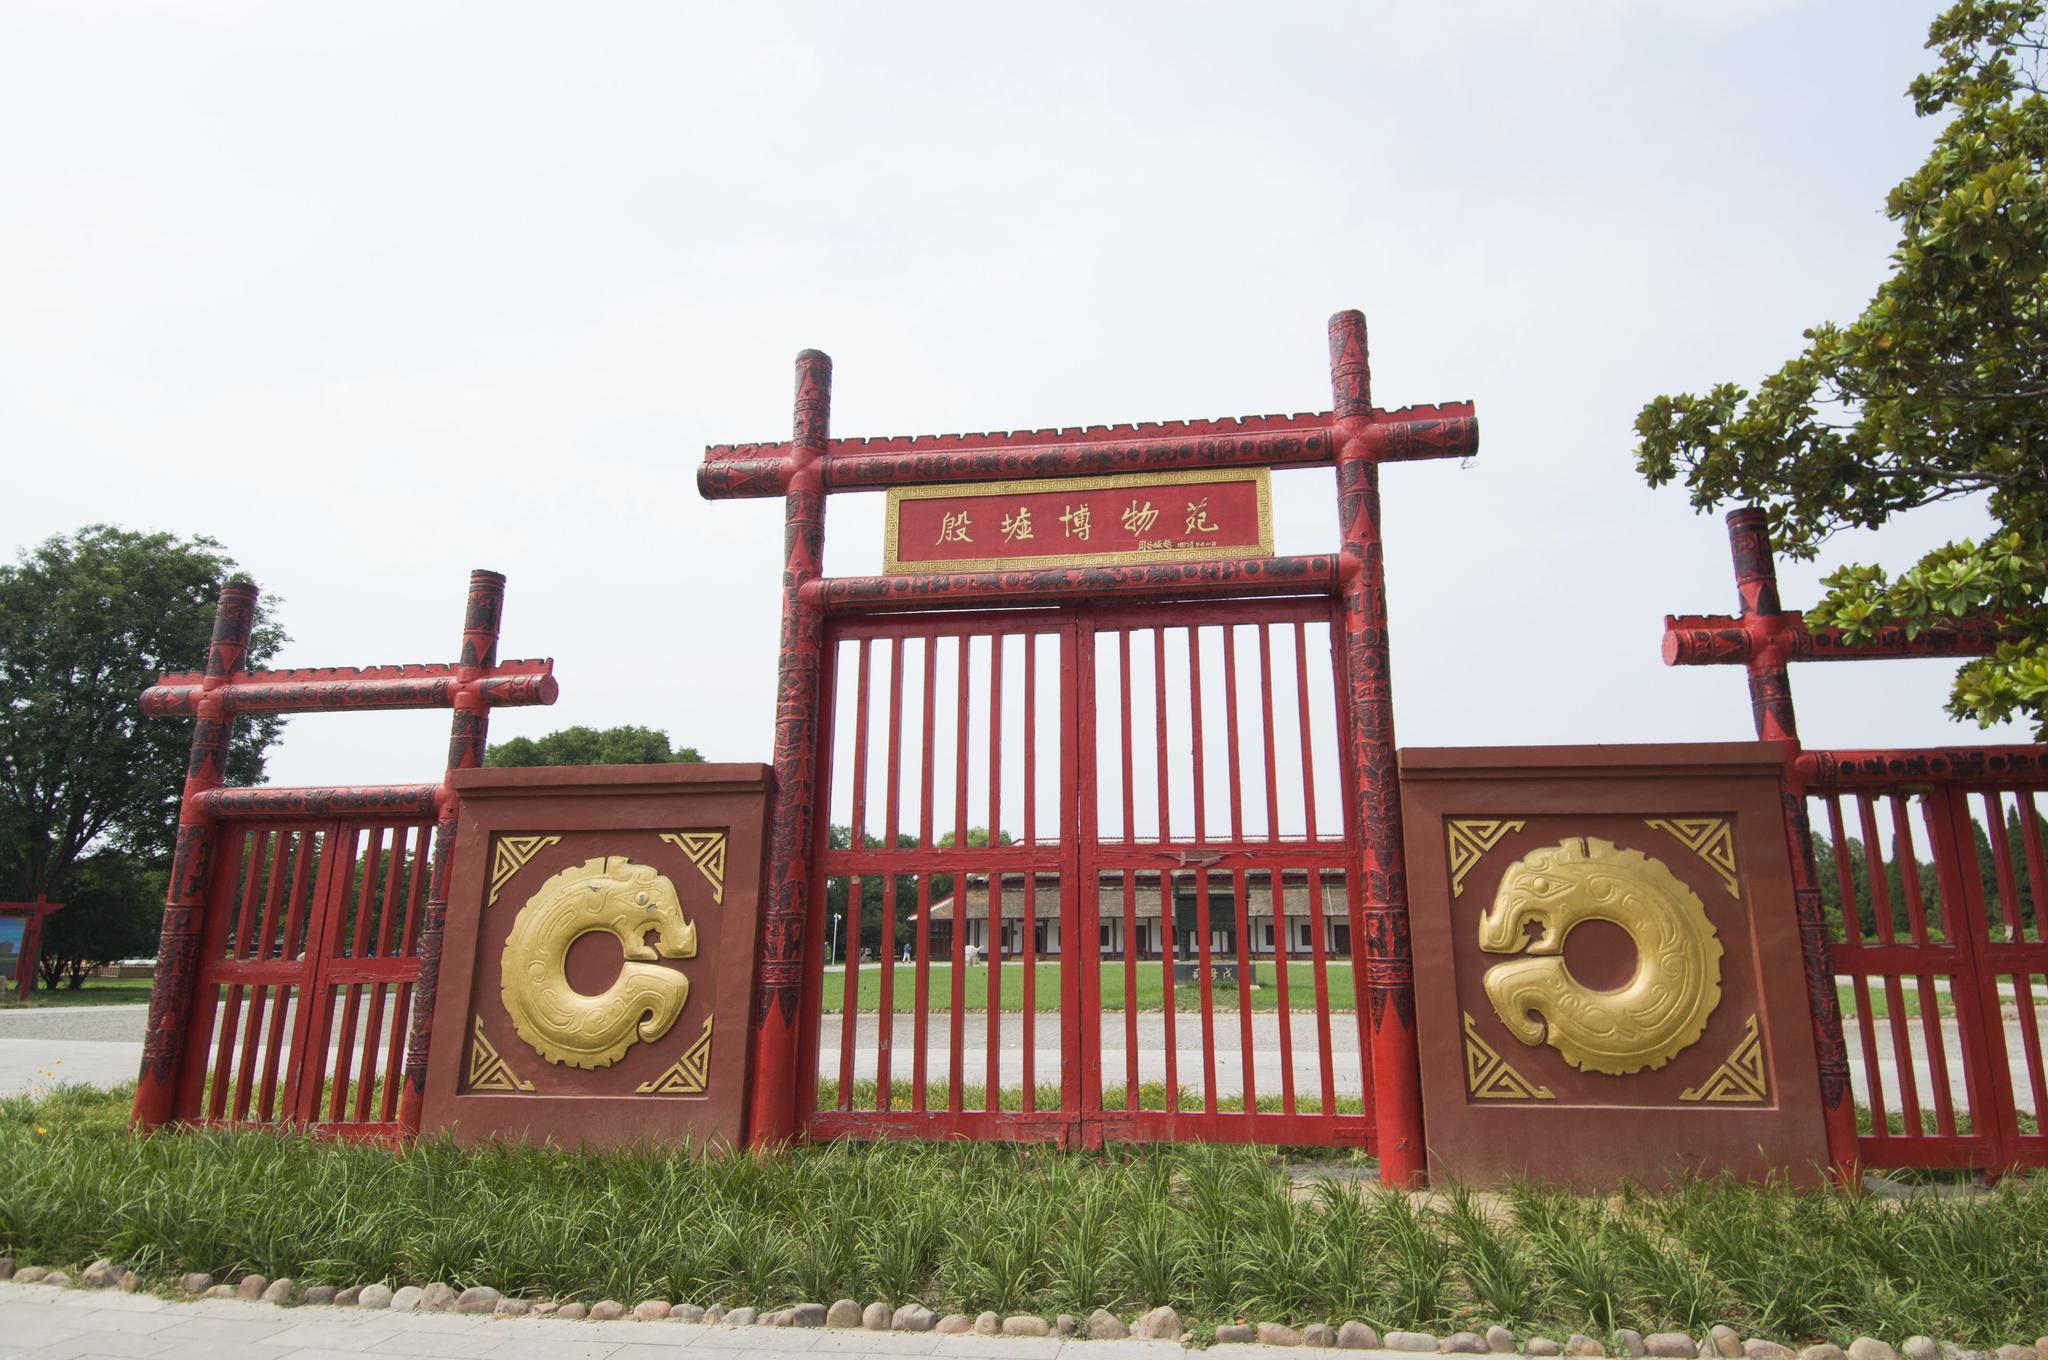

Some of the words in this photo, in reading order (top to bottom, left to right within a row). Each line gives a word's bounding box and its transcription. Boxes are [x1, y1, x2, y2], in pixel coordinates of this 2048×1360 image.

[936, 497, 1219, 545] 殷墟博物苑
